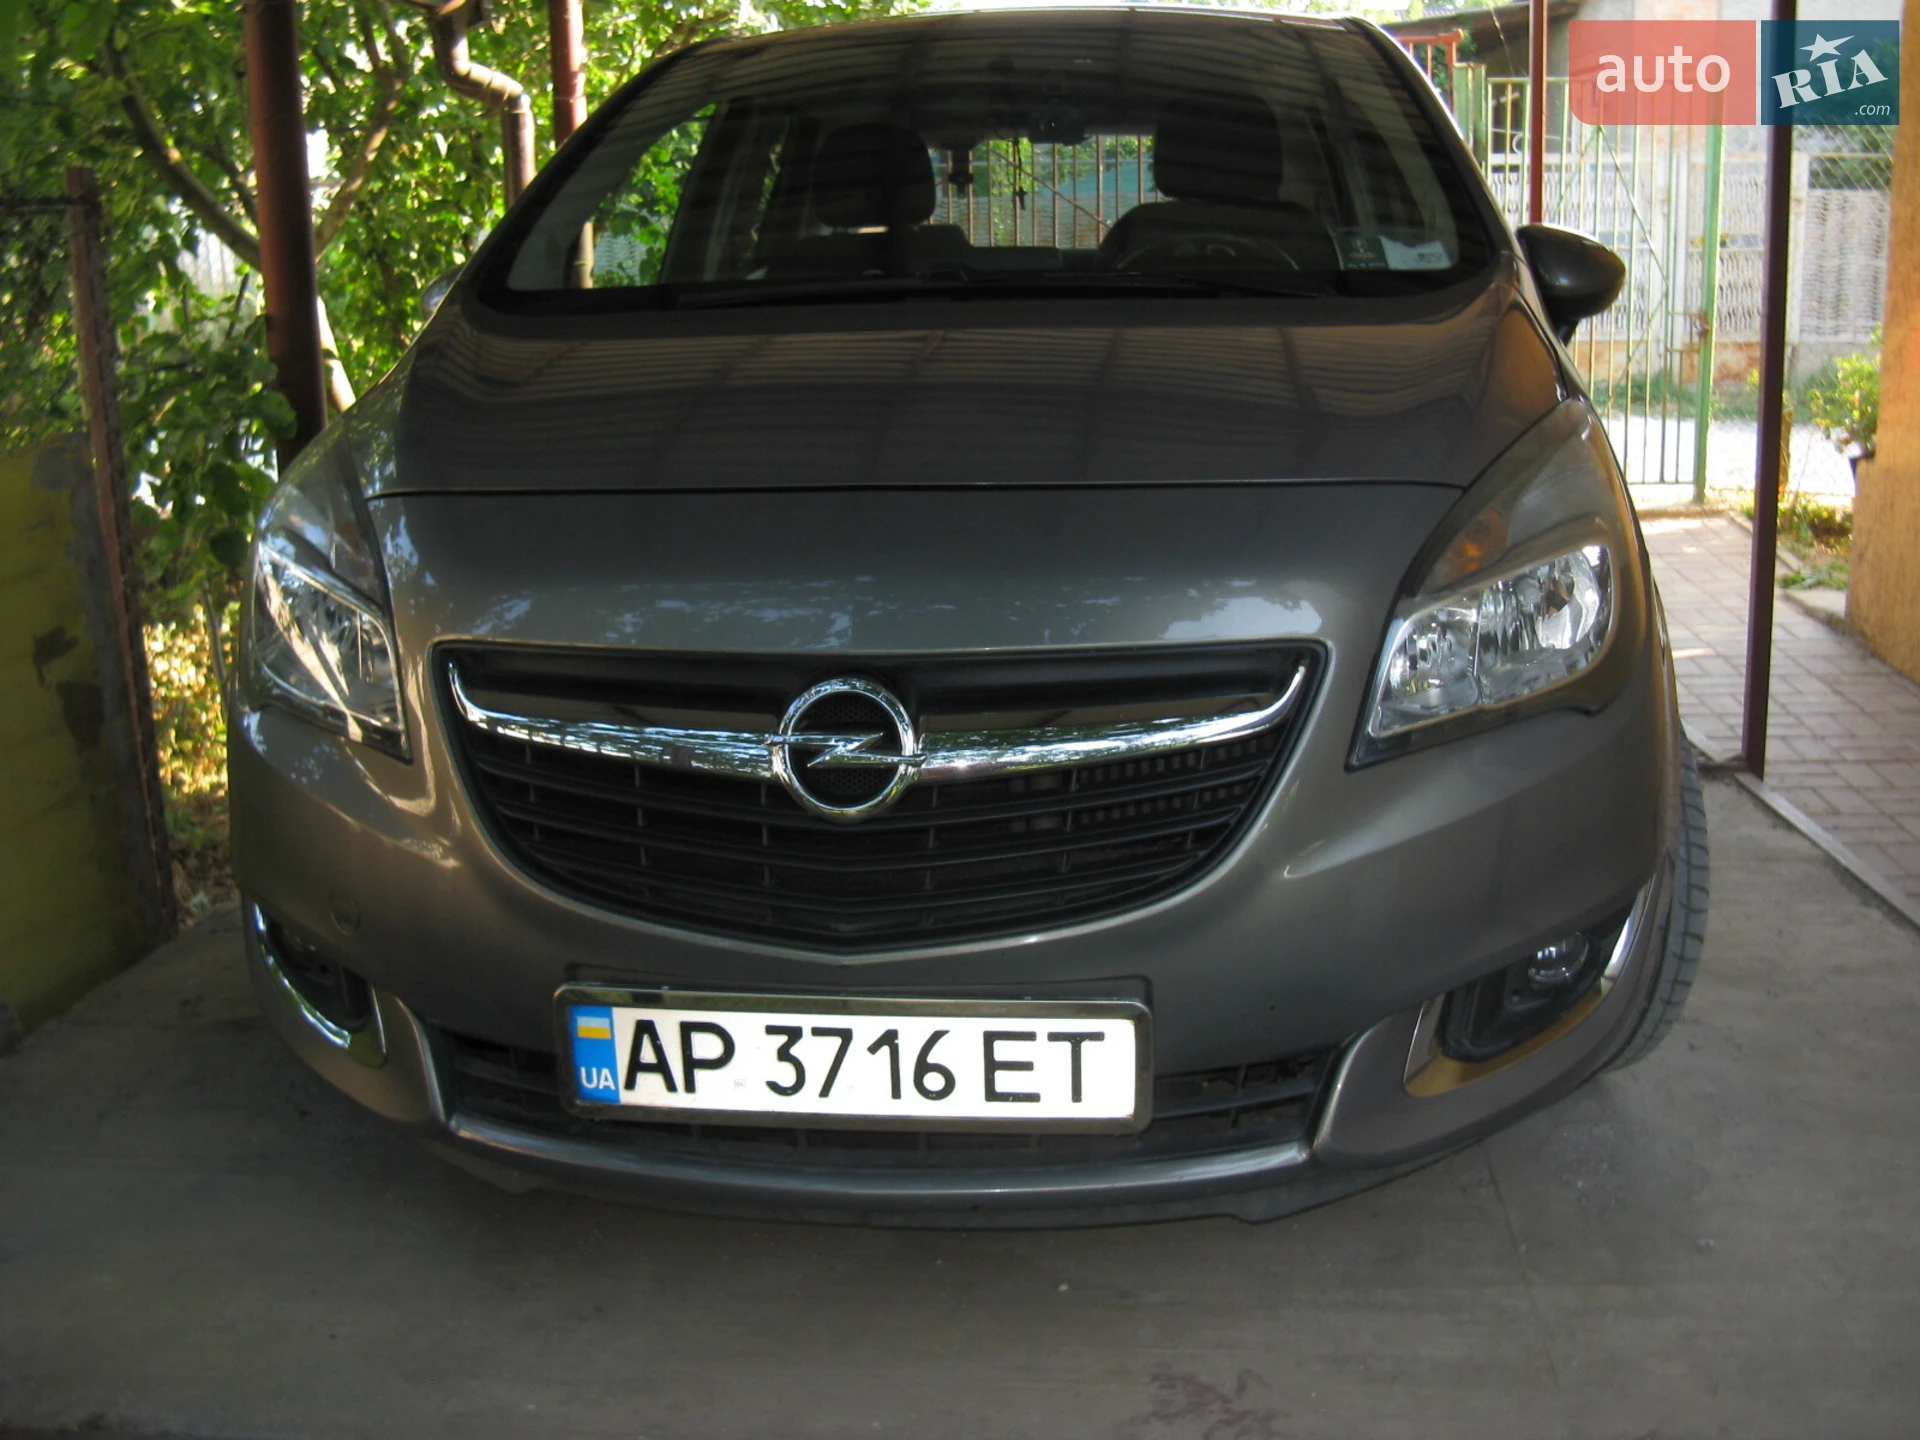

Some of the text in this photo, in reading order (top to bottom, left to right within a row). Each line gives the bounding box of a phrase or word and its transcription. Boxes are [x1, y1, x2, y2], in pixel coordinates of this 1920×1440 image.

[580, 1066, 616, 1091] UA
[623, 1019, 1105, 1103] AP 3716 ET
